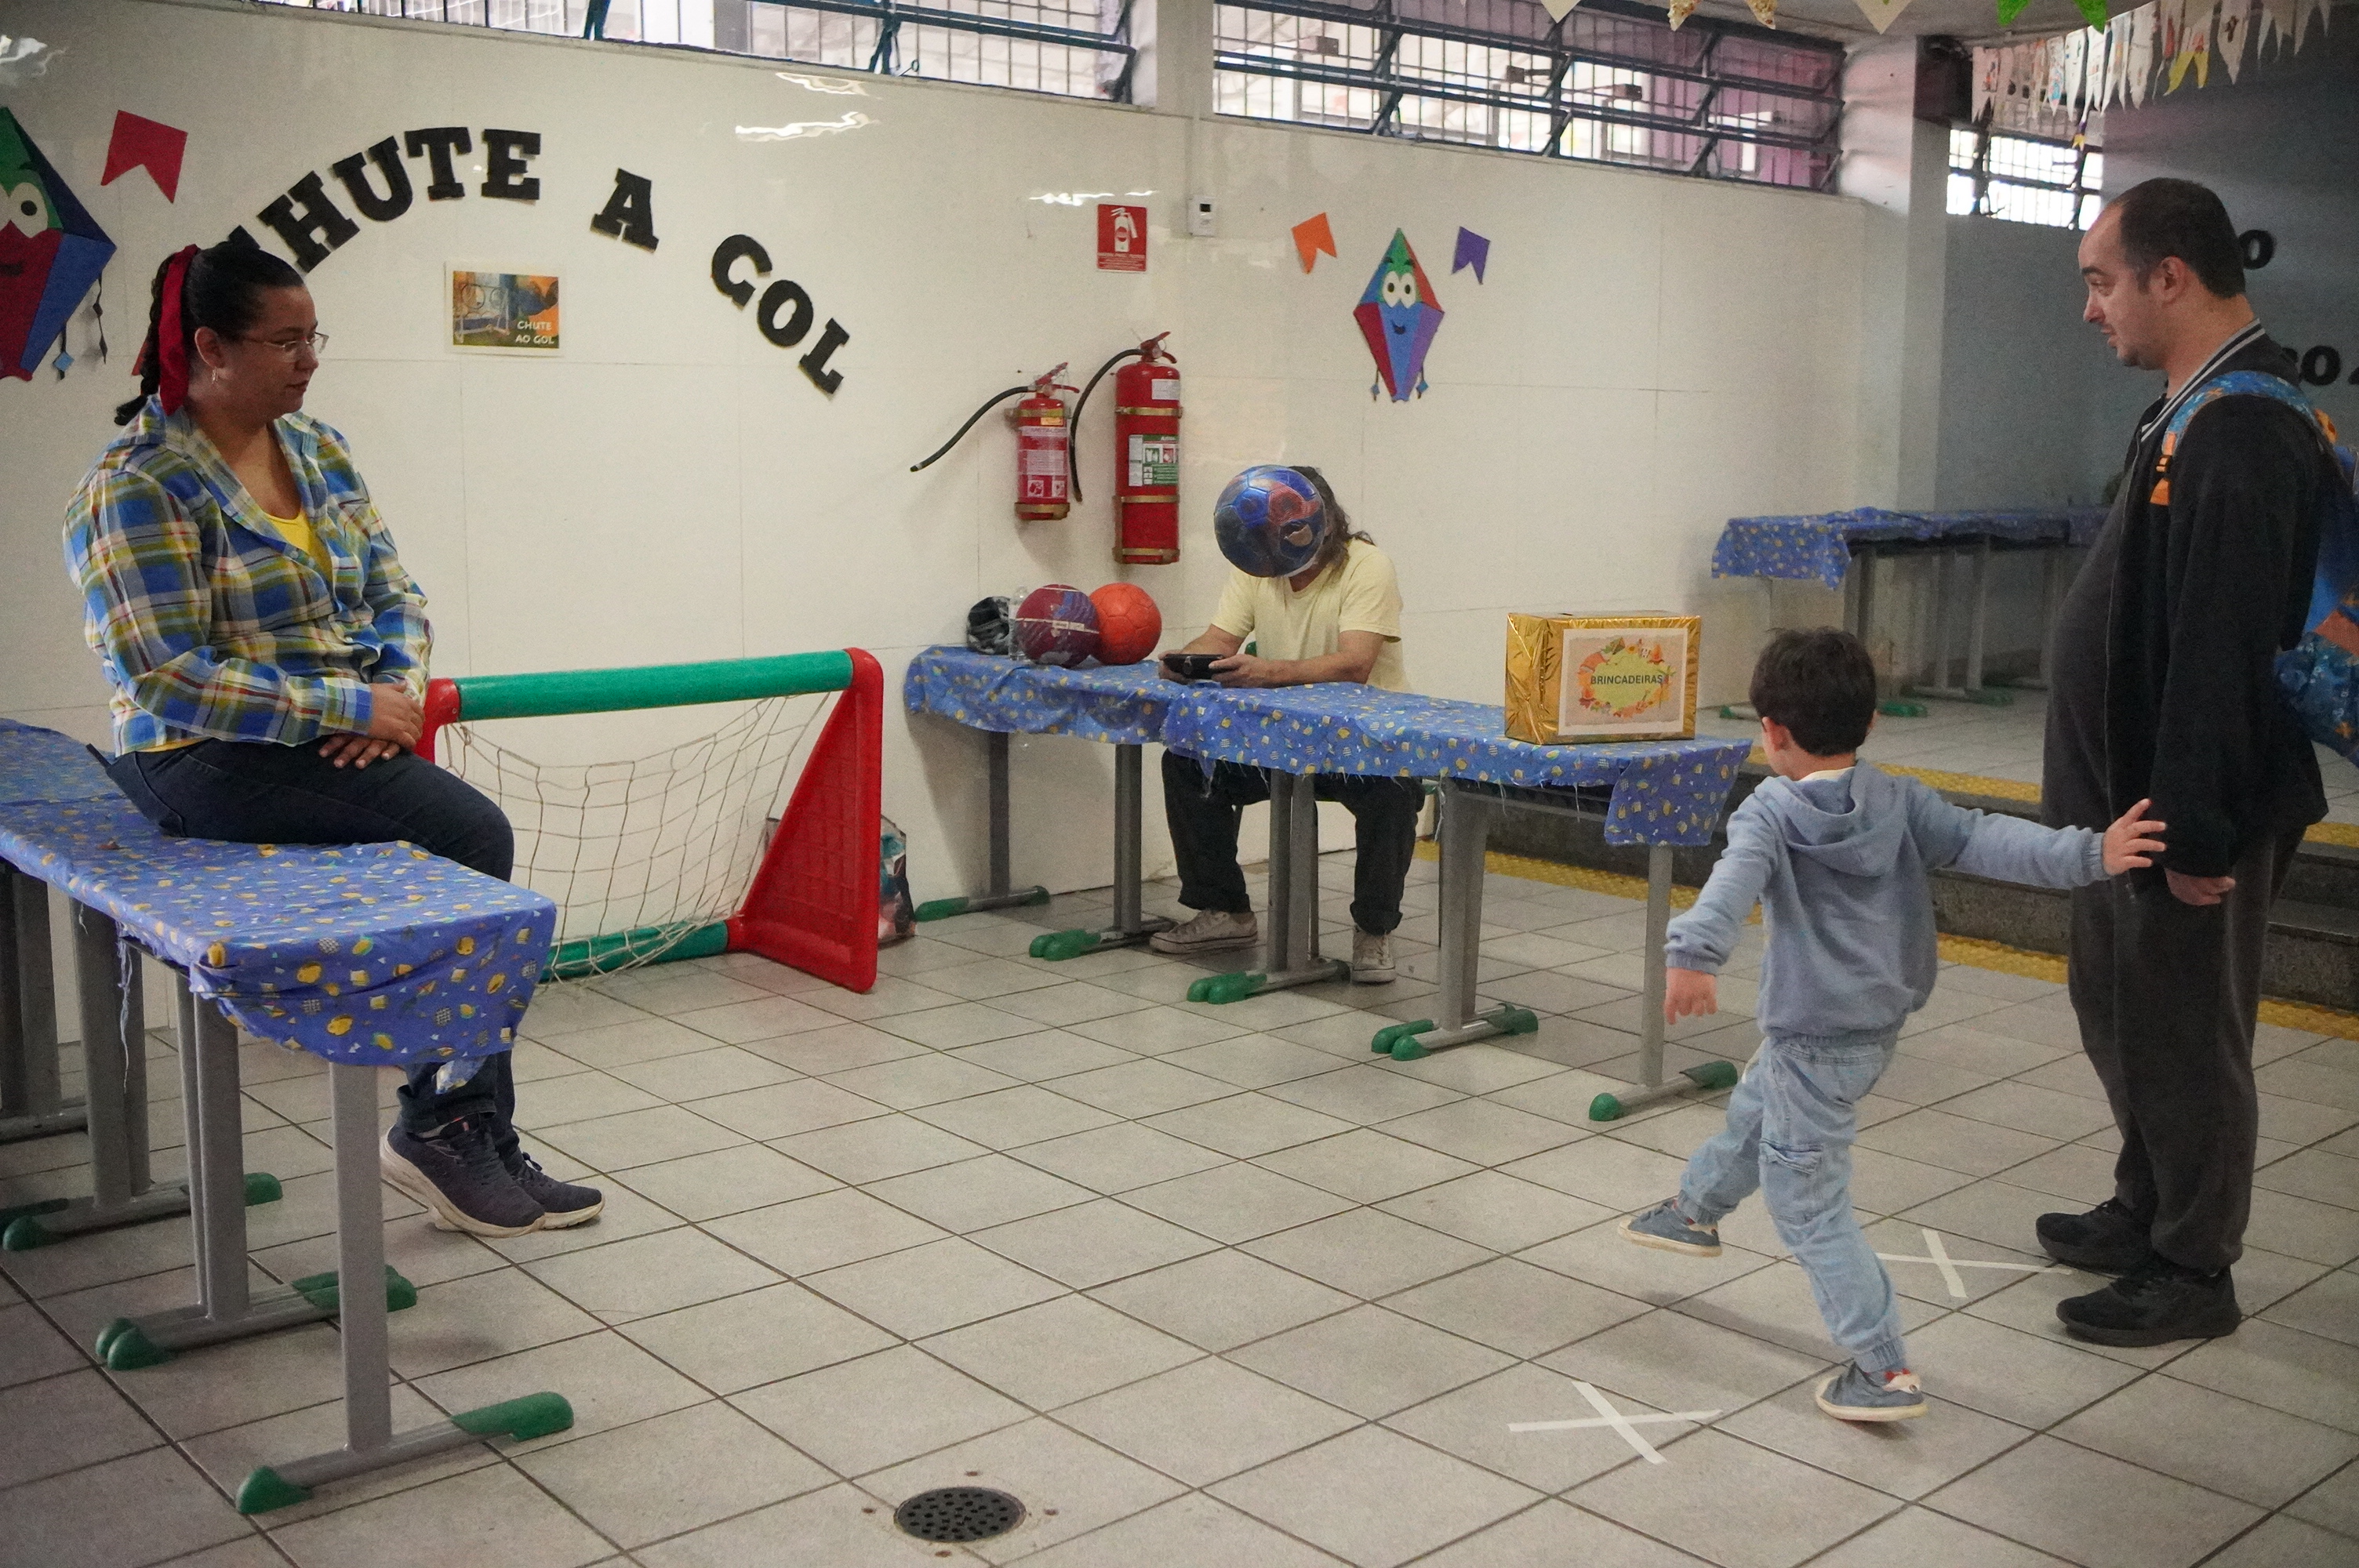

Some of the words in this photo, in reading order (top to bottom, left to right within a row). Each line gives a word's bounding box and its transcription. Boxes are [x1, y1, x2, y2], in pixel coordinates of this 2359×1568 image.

[228, 126, 541, 274] HUTE
[591, 168, 659, 253] A
[711, 234, 850, 394] GOL
[518, 321, 551, 330] CHUTE
[515, 334, 531, 343] AO
[533, 335, 554, 344] GOL
[1590, 674, 1663, 684] BRINCADEIRAS
